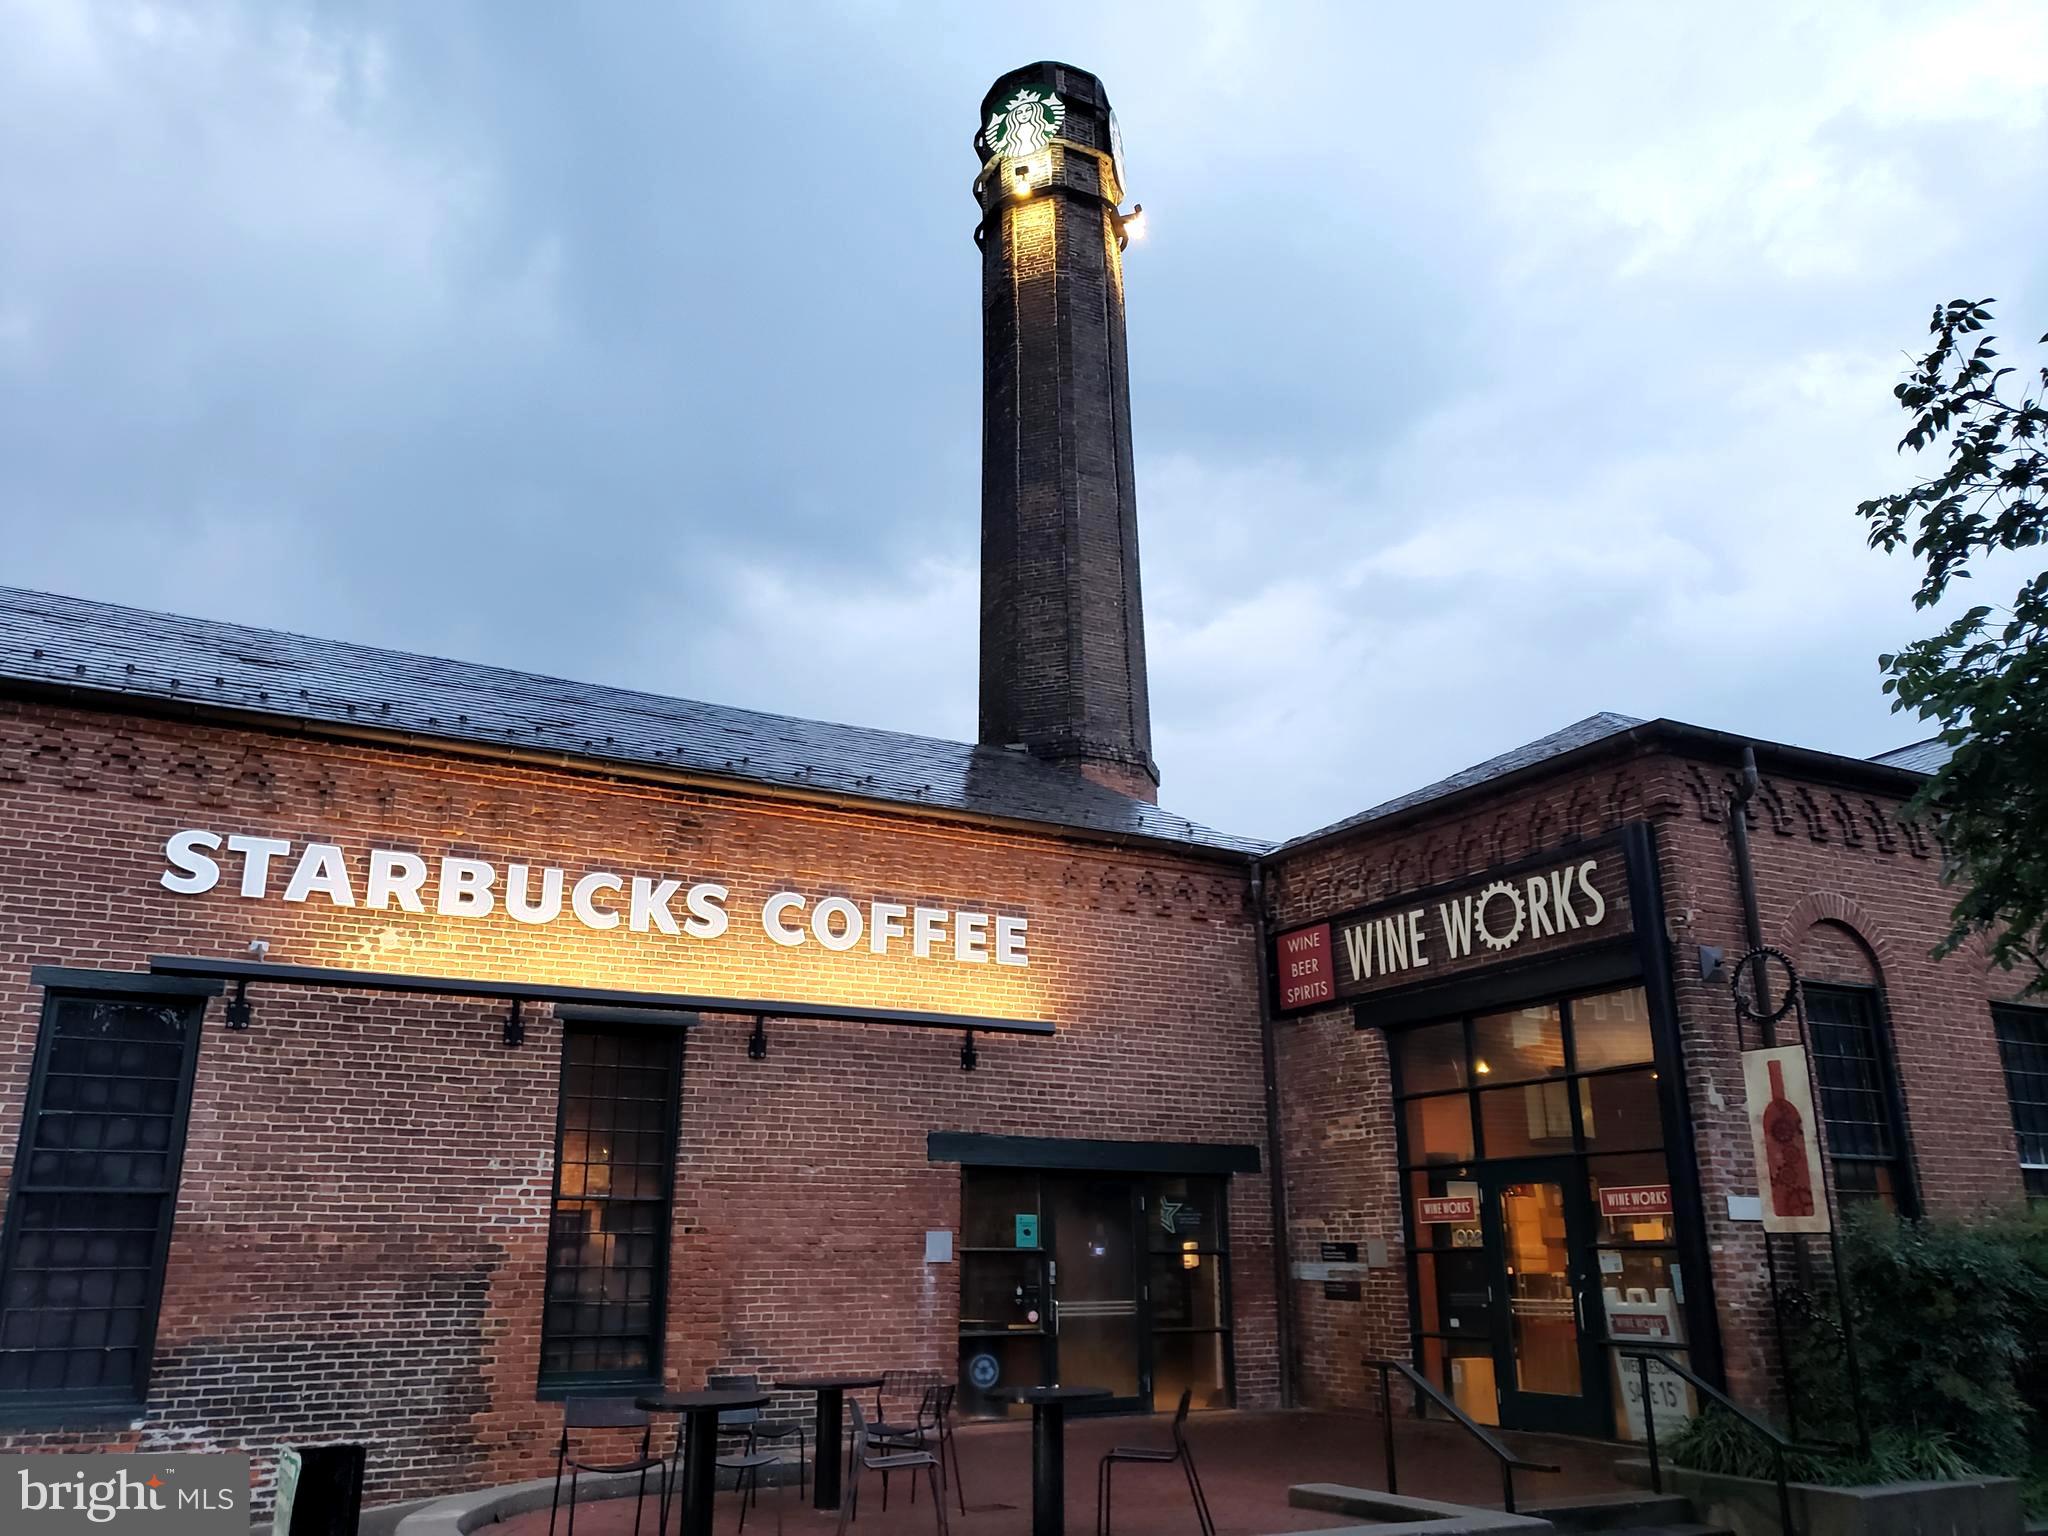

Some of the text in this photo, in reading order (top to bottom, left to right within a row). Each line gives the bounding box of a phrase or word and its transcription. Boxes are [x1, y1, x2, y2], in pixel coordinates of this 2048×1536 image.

[160, 829, 1031, 968] STARBUCKS COFFEE
[1344, 860, 1606, 981] WINE WORKS
[1287, 932, 1321, 952] WINE
[1291, 959, 1319, 978] BEER
[1287, 981, 1329, 1004] SPIRITS
[1423, 1201, 1470, 1215] WINE WORKS
[1606, 1191, 1668, 1206] WINE WORKS
